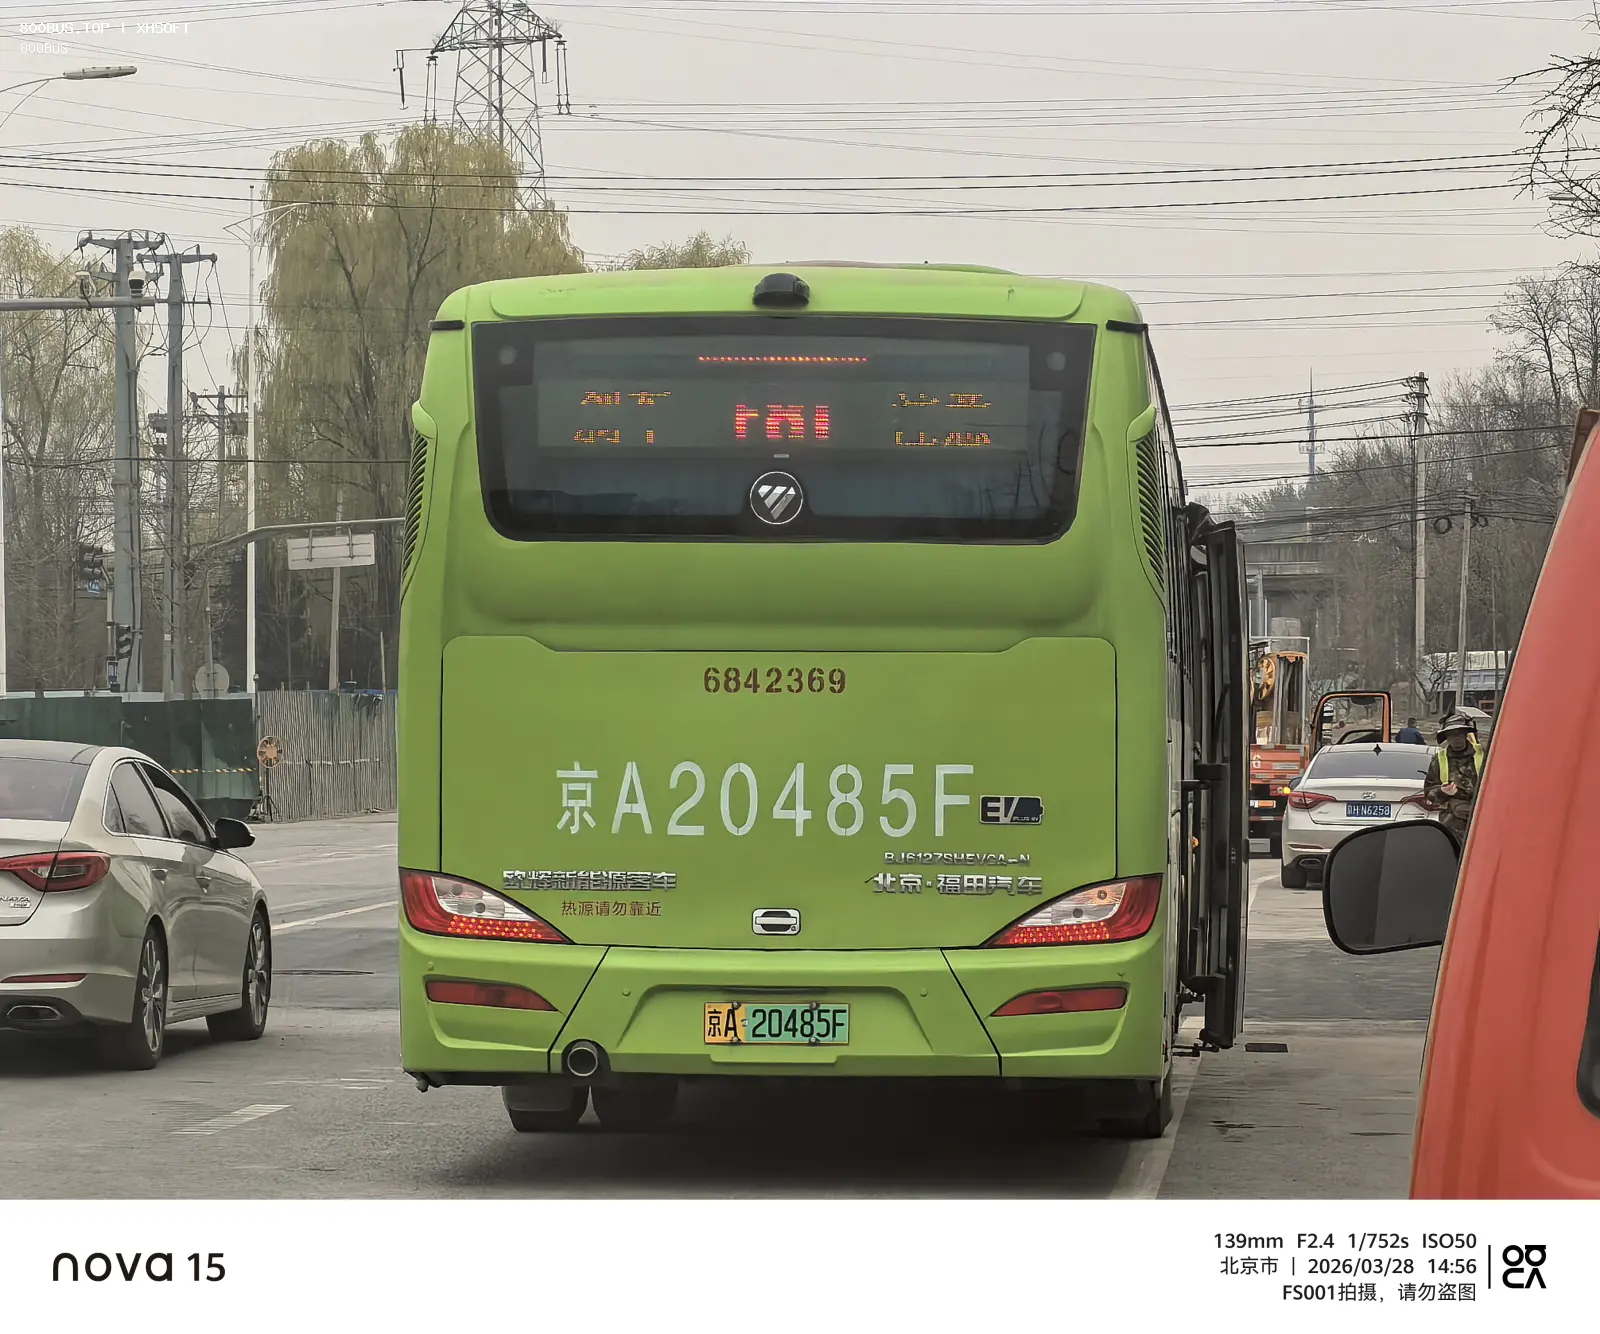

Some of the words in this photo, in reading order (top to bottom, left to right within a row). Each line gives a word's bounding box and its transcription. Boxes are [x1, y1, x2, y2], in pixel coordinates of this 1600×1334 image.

[704, 667, 846, 694] 6842369
[556, 761, 974, 837] 京A20485F
[986, 797, 1020, 822] EV
[502, 869, 677, 892] 欧辉新能源客车
[561, 900, 662, 917] 热源请勿靠近
